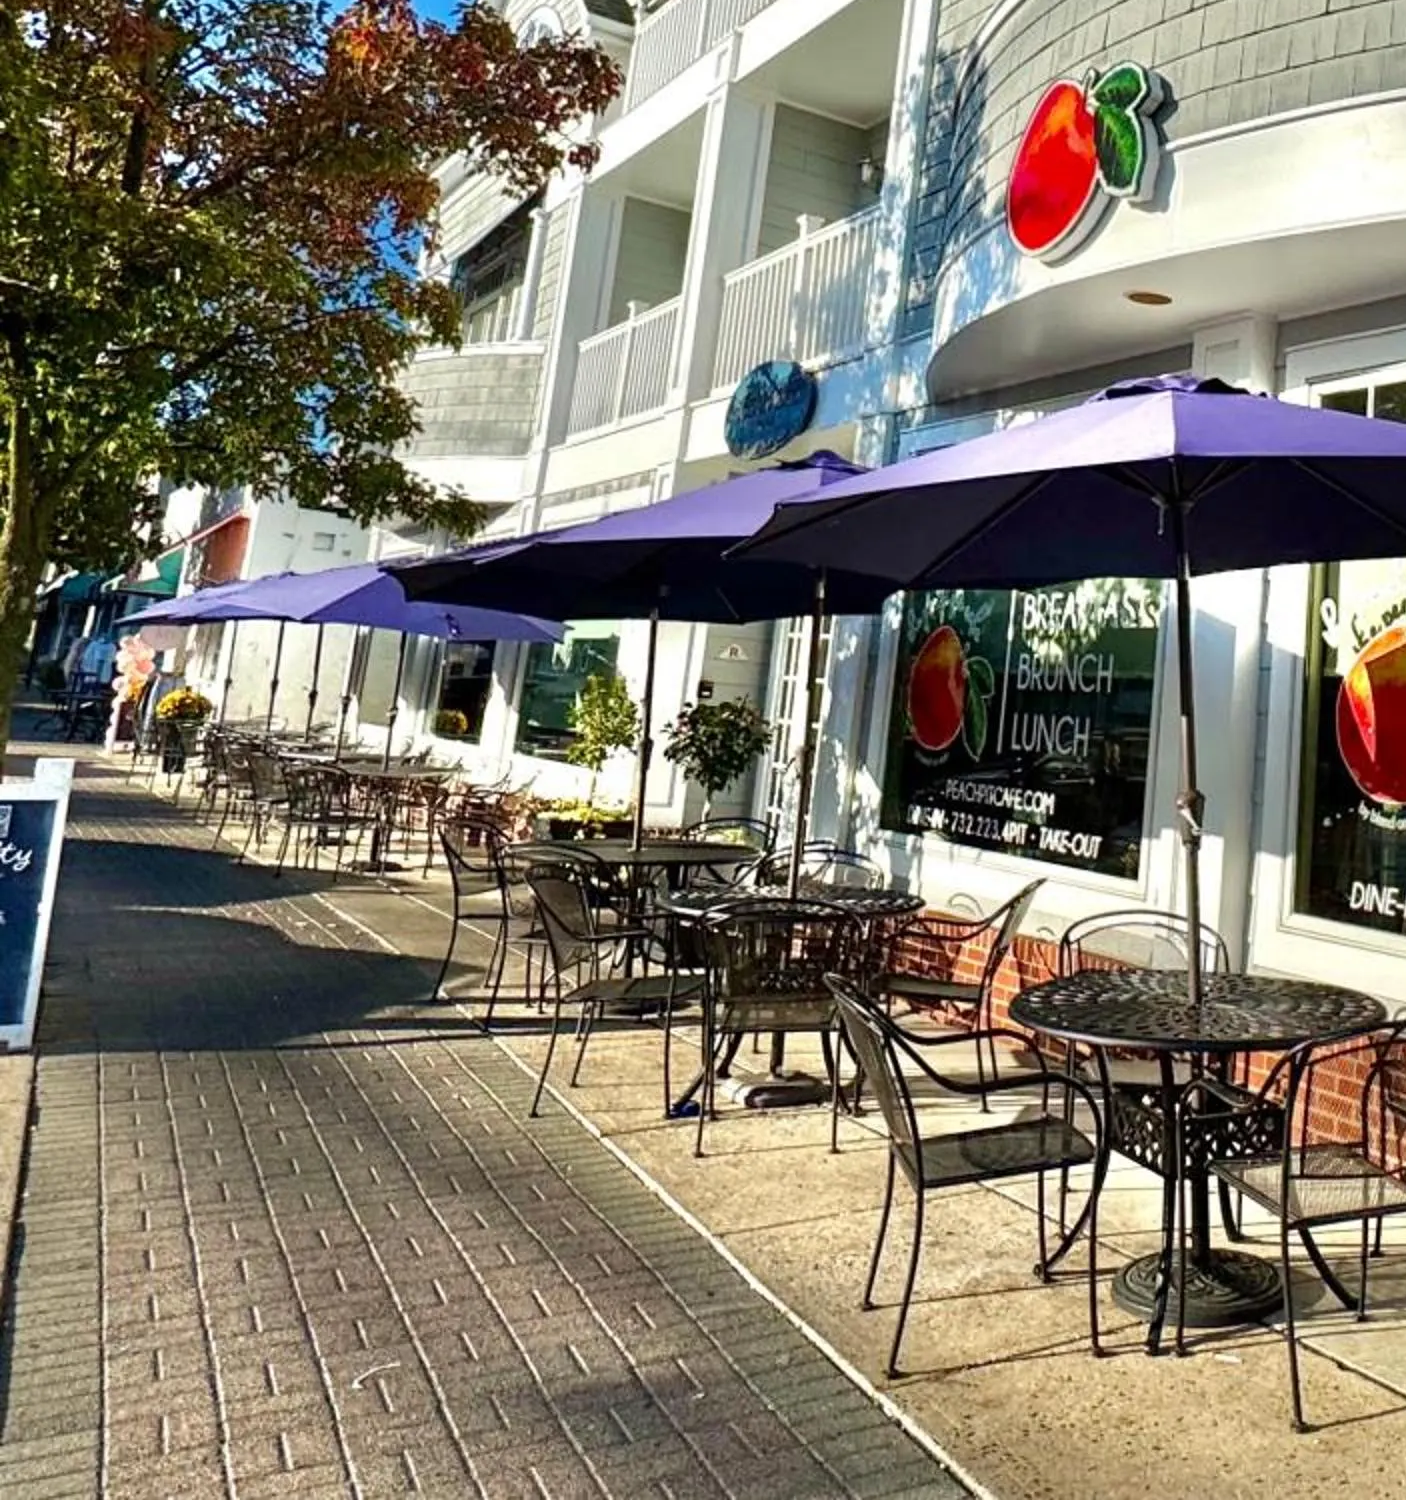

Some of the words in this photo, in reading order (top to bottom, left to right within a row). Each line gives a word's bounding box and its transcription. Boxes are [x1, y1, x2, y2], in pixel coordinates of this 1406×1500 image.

[1017, 653, 1114, 693] BRUNCH
[1011, 713, 1091, 757] LUNCH
[1039, 826, 1103, 860] TAKE-OUT
